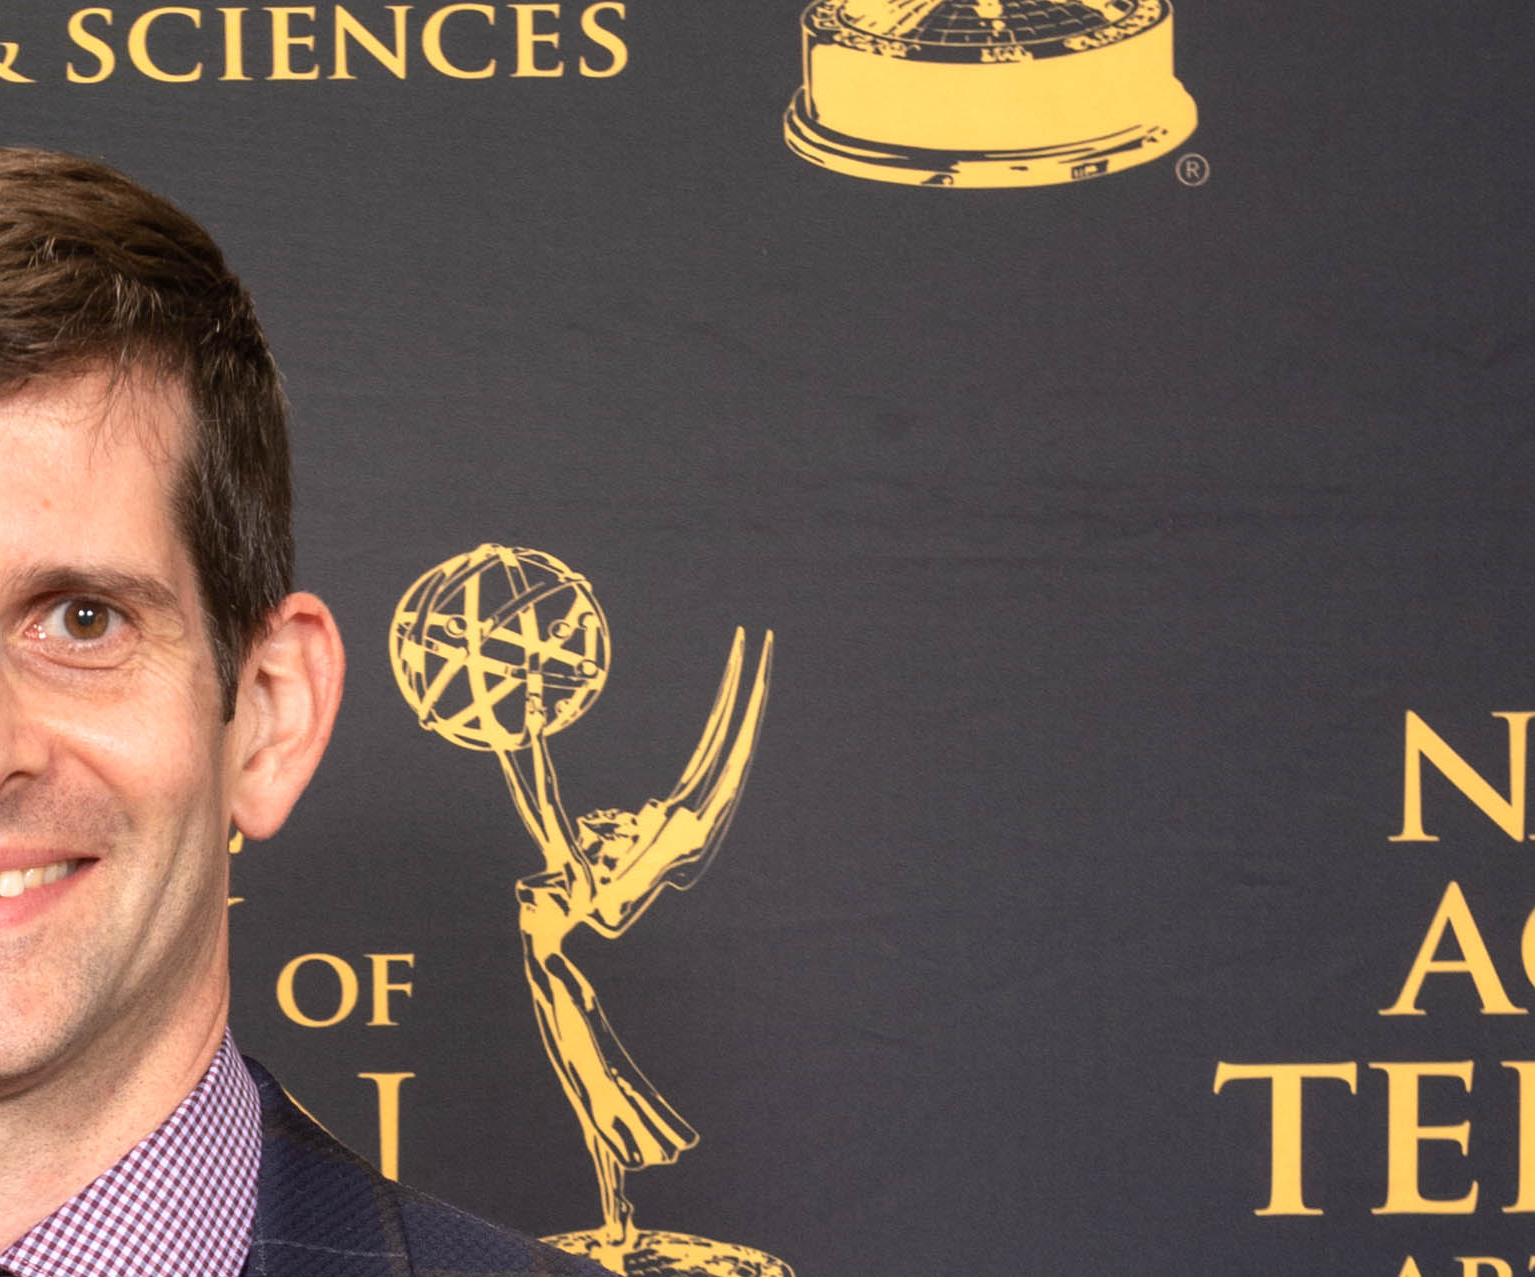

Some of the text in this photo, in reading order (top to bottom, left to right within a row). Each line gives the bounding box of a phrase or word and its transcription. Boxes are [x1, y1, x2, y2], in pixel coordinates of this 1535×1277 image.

[66, 1, 629, 84] SCIENCES
[1388, 709, 1535, 842] N
[276, 952, 415, 1028] OF
[1377, 880, 1535, 1015] A
